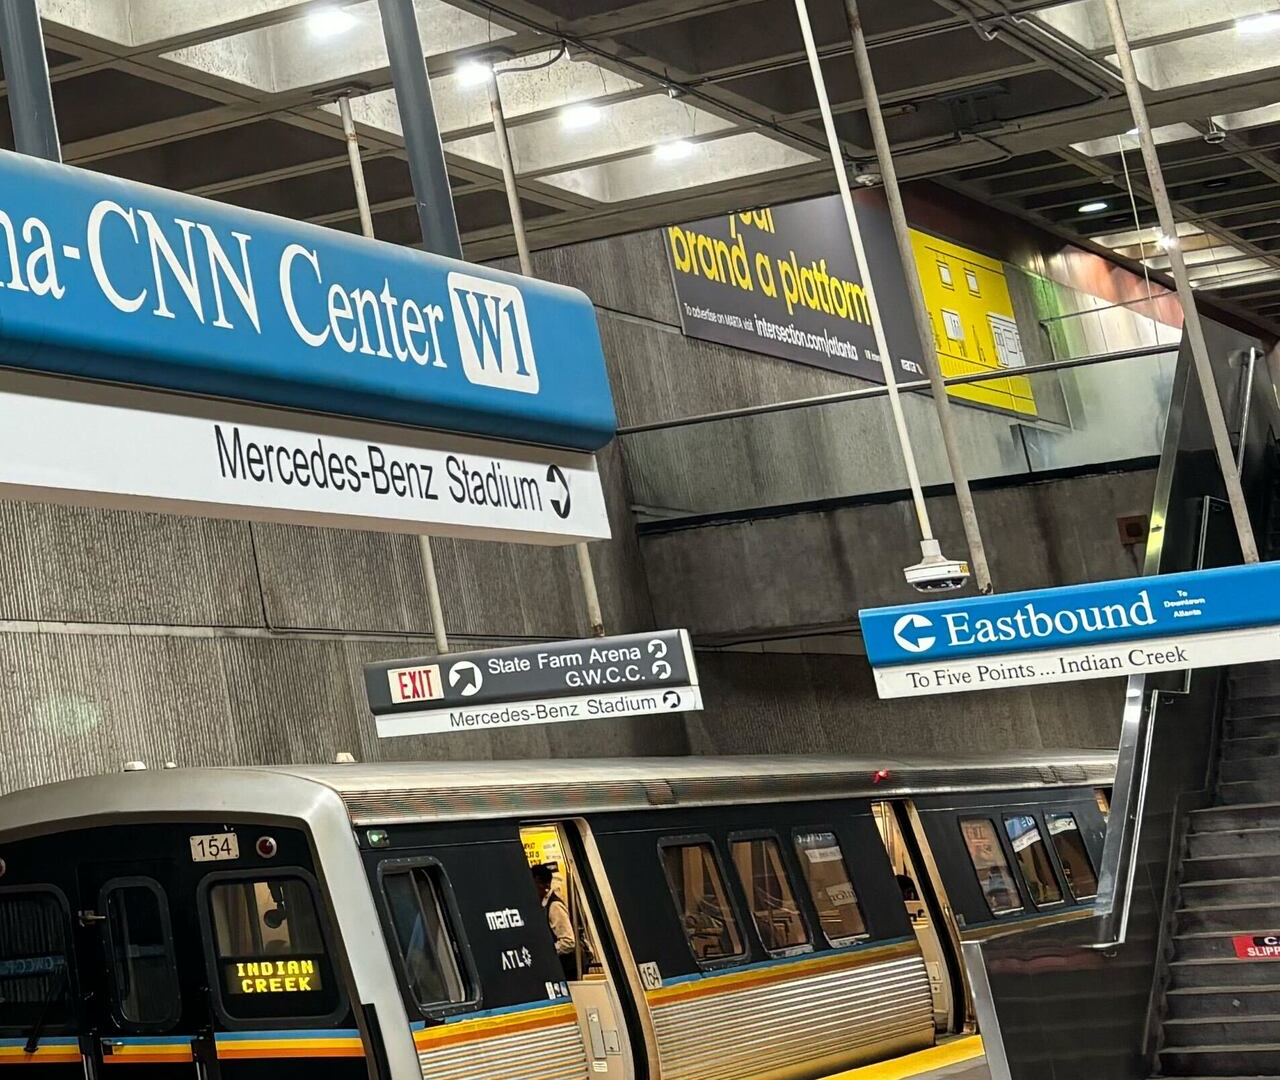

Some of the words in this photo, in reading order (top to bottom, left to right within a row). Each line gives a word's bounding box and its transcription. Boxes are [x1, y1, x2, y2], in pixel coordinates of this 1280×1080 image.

[668, 226, 753, 291] brand
[756, 252, 777, 298] a
[777, 250, 871, 326] platform
[279, 243, 448, 368] Center
[453, 288, 530, 376] W1
[754, 313, 858, 361] intersection.com/atlanta
[214, 424, 438, 500] Mercedes-Benz
[447, 454, 543, 513] Stadium
[941, 590, 1158, 648] Eastbound
[488, 658, 531, 675] State
[538, 652, 582, 671] Farm
[589, 646, 642, 666] Arena
[906, 672, 930, 689] To
[935, 670, 972, 687] Five
[977, 664, 1036, 682] Points
[1059, 656, 1123, 674] Indian
[1128, 646, 1189, 666] Creek
[397, 669, 435, 701] EXIT
[565, 667, 646, 688] G.W.C.C.
[449, 702, 580, 728] Mercedes-Benz
[587, 694, 657, 716] Stadium
[197, 837, 232, 858] 154
[485, 908, 524, 930] marta
[236, 960, 314, 977] INDIAN
[501, 950, 524, 970] ATL
[241, 977, 312, 993] CREEK
